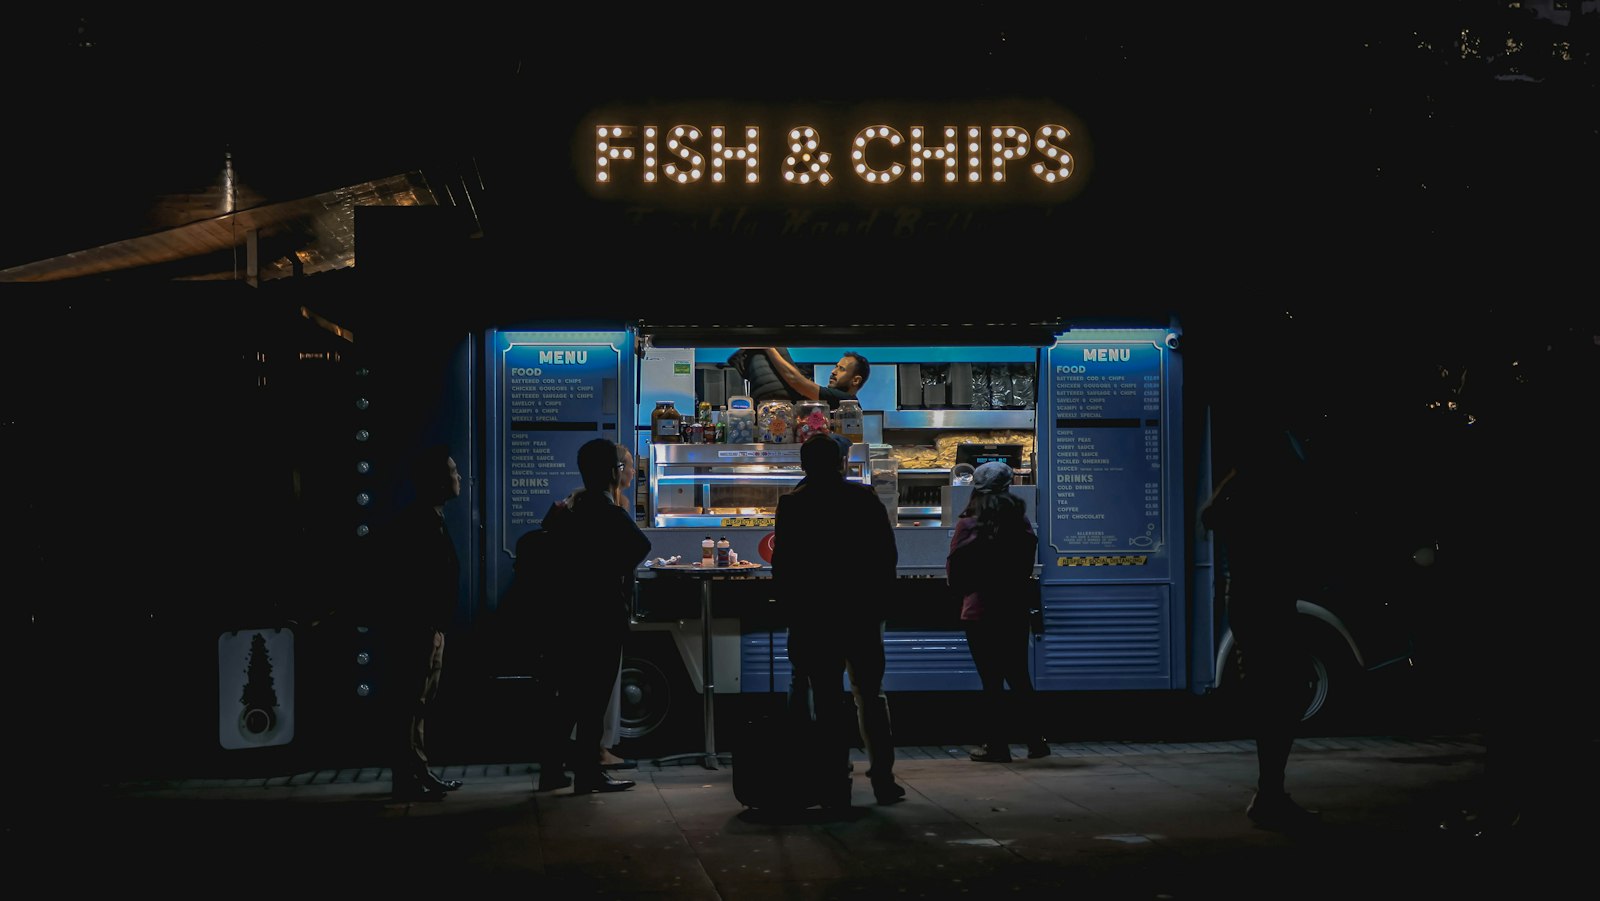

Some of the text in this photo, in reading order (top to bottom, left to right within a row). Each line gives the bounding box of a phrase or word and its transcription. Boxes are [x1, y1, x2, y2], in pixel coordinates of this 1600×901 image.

[595, 125, 1076, 185] FISH & CHIPS
[539, 350, 588, 365] MENU
[1083, 348, 1130, 362] MENU
[511, 368, 542, 376] FOOD
[1056, 365, 1086, 374] FOOD
[512, 478, 549, 487] DRINKS
[1057, 474, 1094, 483] DRINKS
